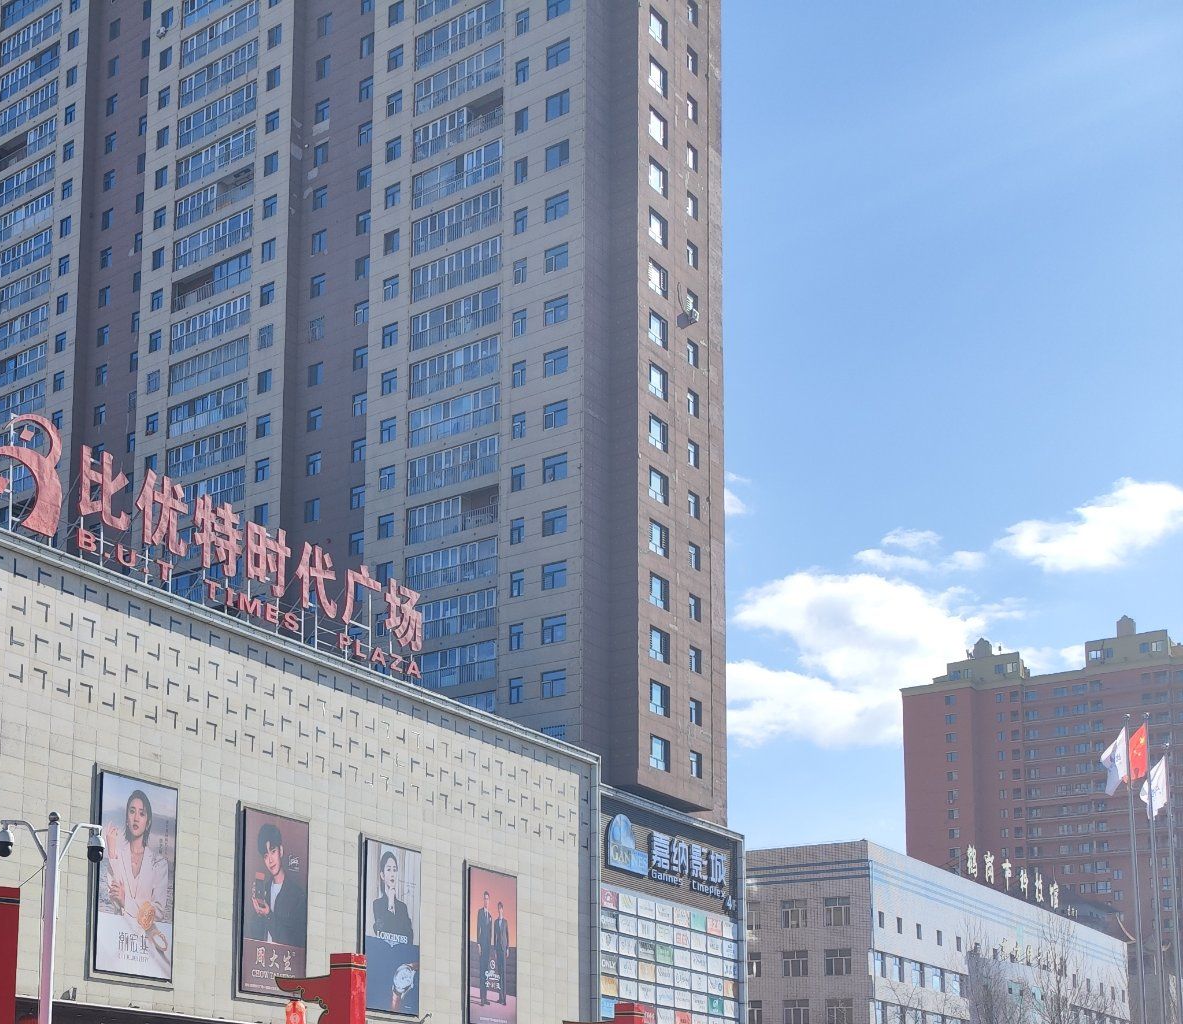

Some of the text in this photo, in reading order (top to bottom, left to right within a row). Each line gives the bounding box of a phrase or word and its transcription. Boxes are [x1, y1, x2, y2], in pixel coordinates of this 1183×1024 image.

[78, 444, 424, 652] 比优特时代广场
[203, 578, 301, 632] TIMES
[338, 632, 423, 679] PLAZA
[651, 830, 728, 886] 嘉纳影城
[651, 869, 684, 887] Gannes
[692, 880, 727, 900] Cineplex
[255, 946, 292, 971] 周大生
[376, 930, 409, 946] LONGINES
